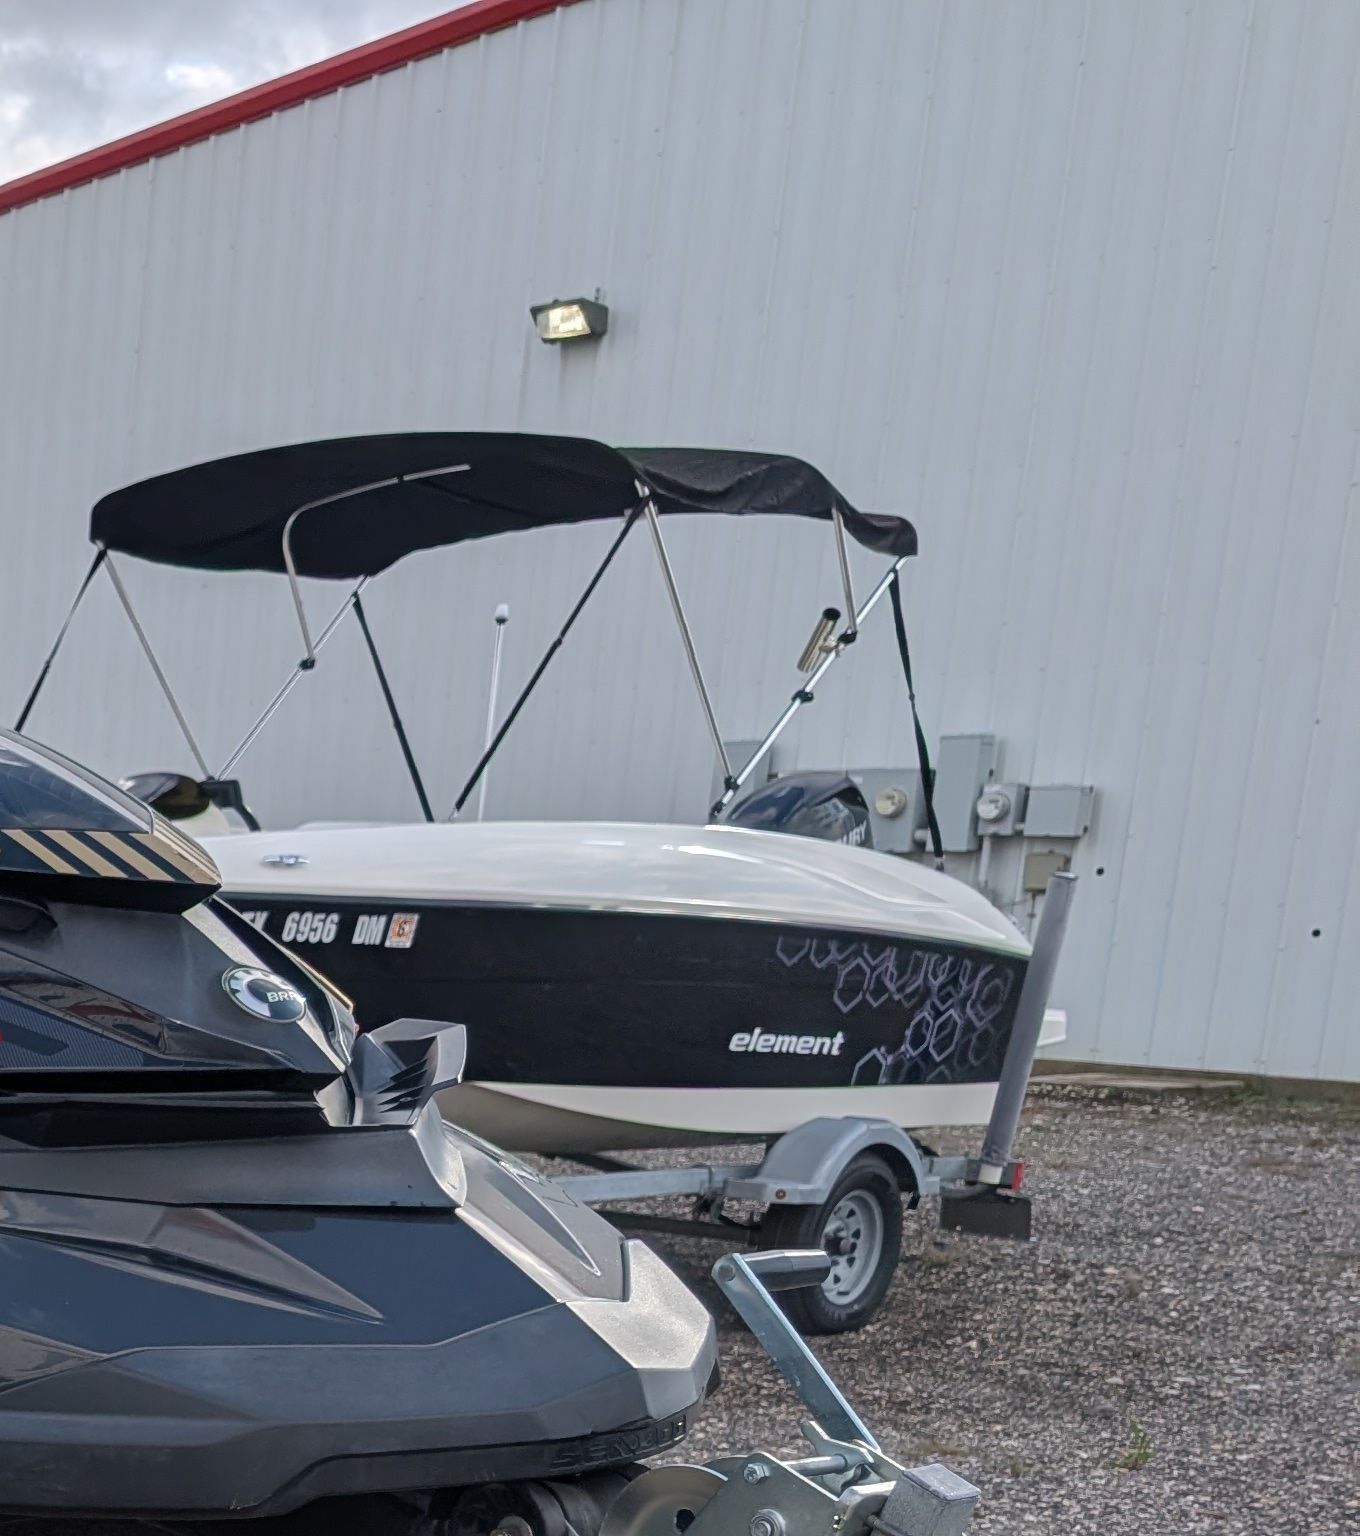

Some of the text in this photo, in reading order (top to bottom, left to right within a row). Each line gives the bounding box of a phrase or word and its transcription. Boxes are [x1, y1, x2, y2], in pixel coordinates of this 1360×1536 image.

[840, 818, 867, 848] URY
[281, 911, 340, 944] 6956
[351, 914, 387, 946] DM
[729, 1026, 846, 1057] element
